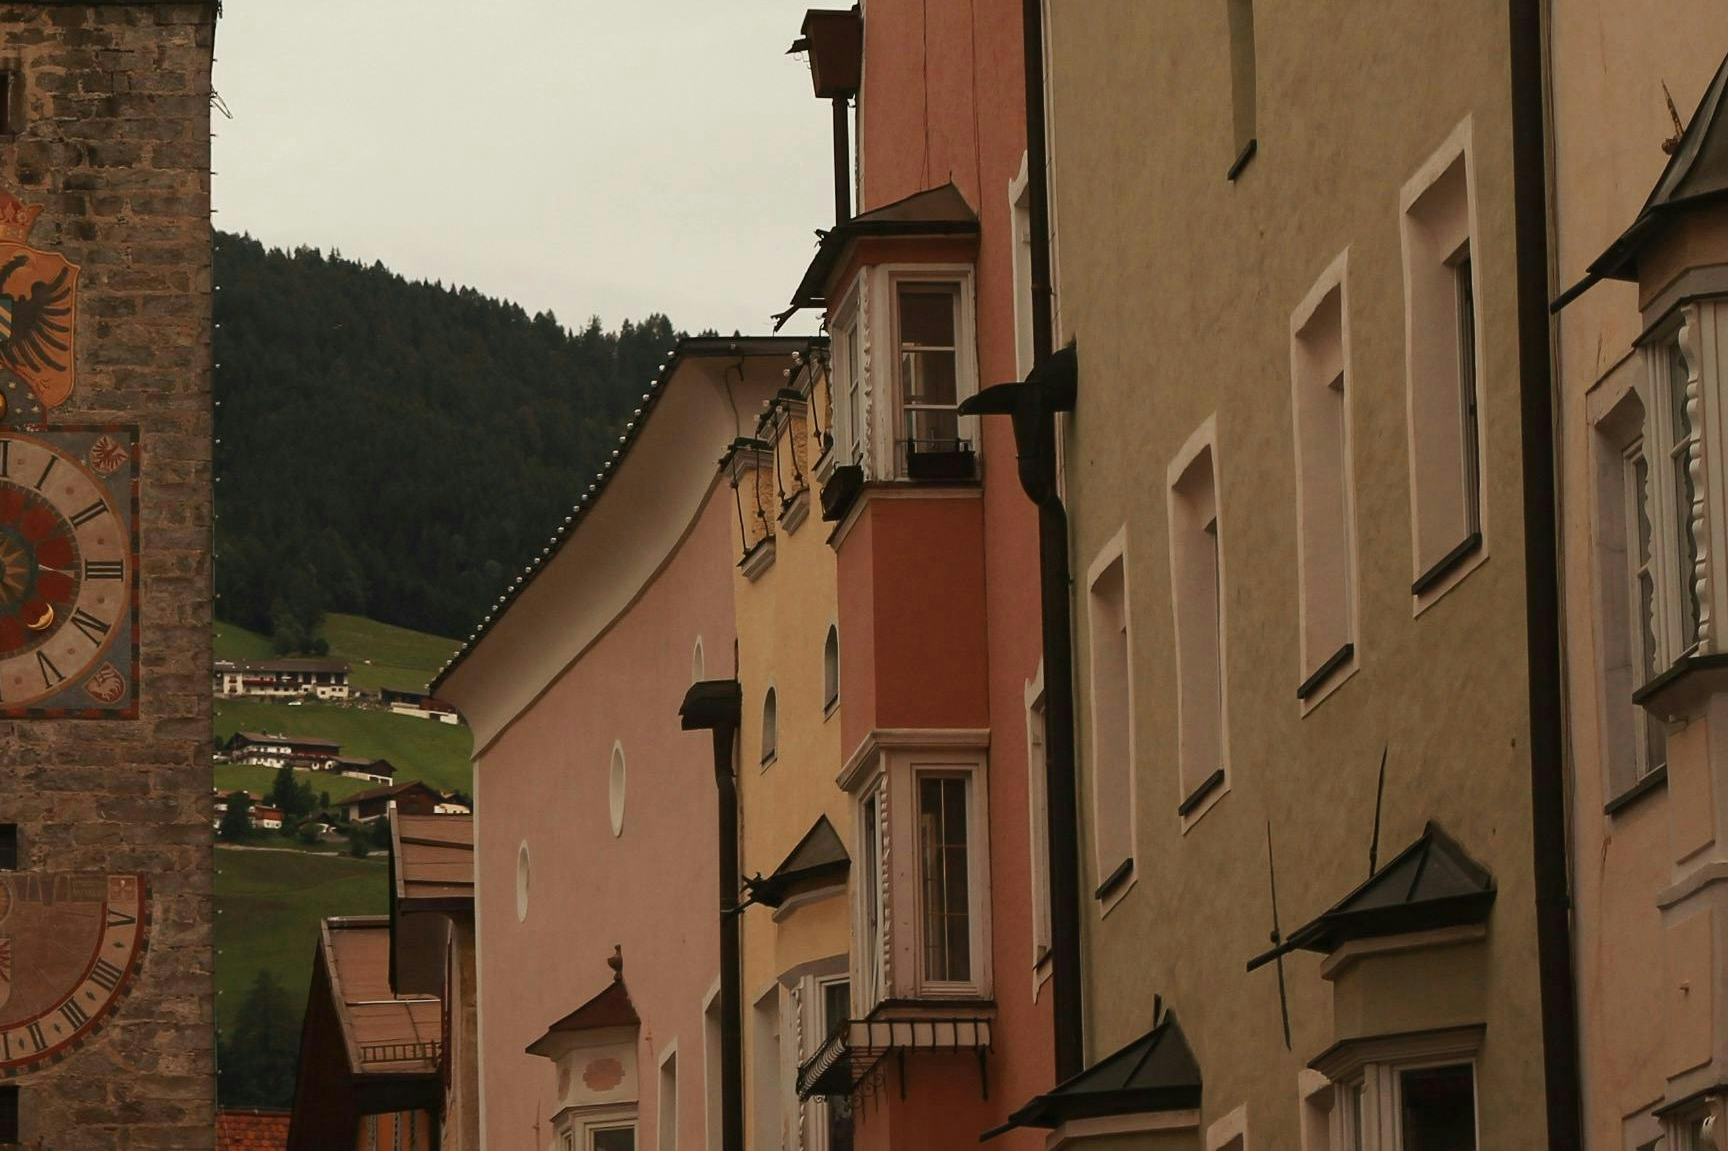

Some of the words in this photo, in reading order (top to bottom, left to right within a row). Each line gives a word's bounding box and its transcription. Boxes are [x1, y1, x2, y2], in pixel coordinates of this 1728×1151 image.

[35, 454, 59, 491] I
[69, 498, 109, 530] II
[84, 559, 123, 582] III
[71, 607, 111, 648] IV
[36, 651, 66, 689] V
[107, 908, 136, 929] V
[58, 997, 91, 1031] III
[26, 1021, 48, 1052] II
